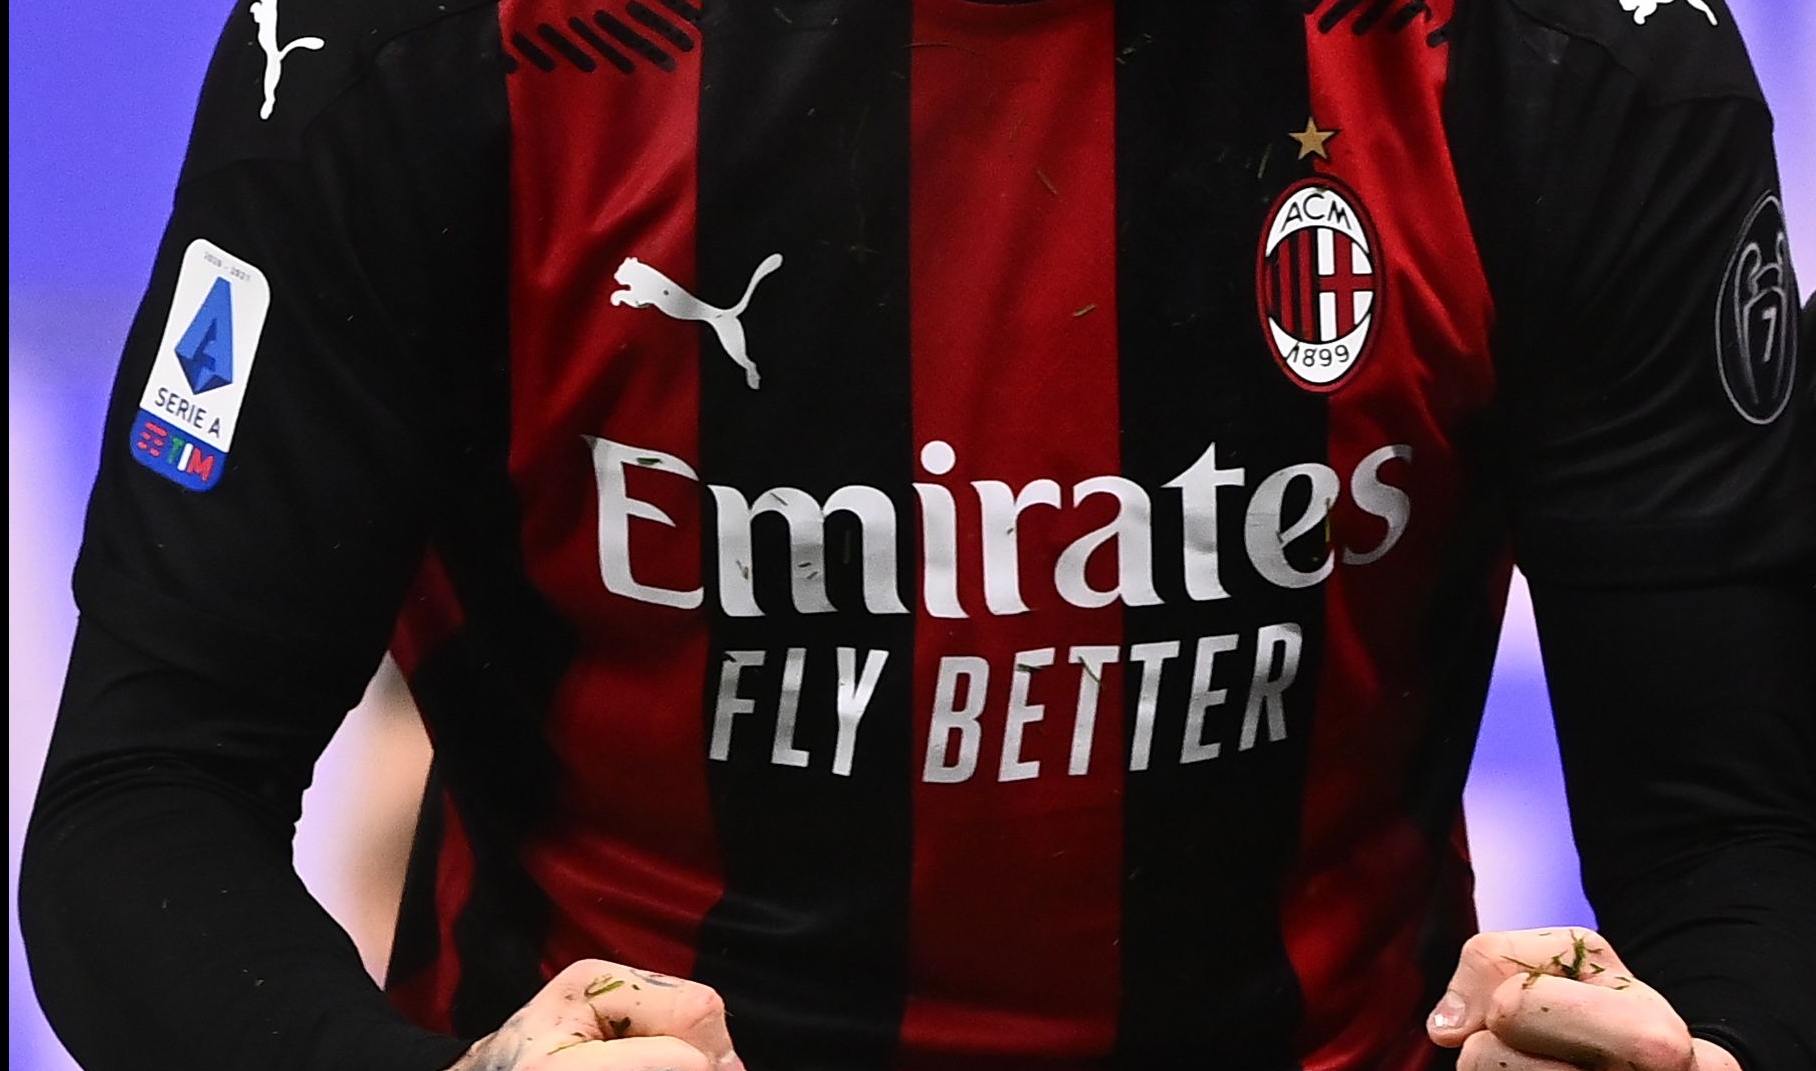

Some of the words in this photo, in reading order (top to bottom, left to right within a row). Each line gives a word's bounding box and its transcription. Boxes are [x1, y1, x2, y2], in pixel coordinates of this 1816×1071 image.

[1281, 193, 1352, 233] ACM
[1285, 341, 1350, 367] 1899
[1761, 306, 1777, 363] 7
[154, 387, 207, 429] SERIE
[208, 416, 222, 439] A
[166, 436, 215, 481] TIM
[582, 435, 1412, 619] Emirates
[709, 647, 889, 776] FLY
[921, 623, 1303, 783] BETTER
